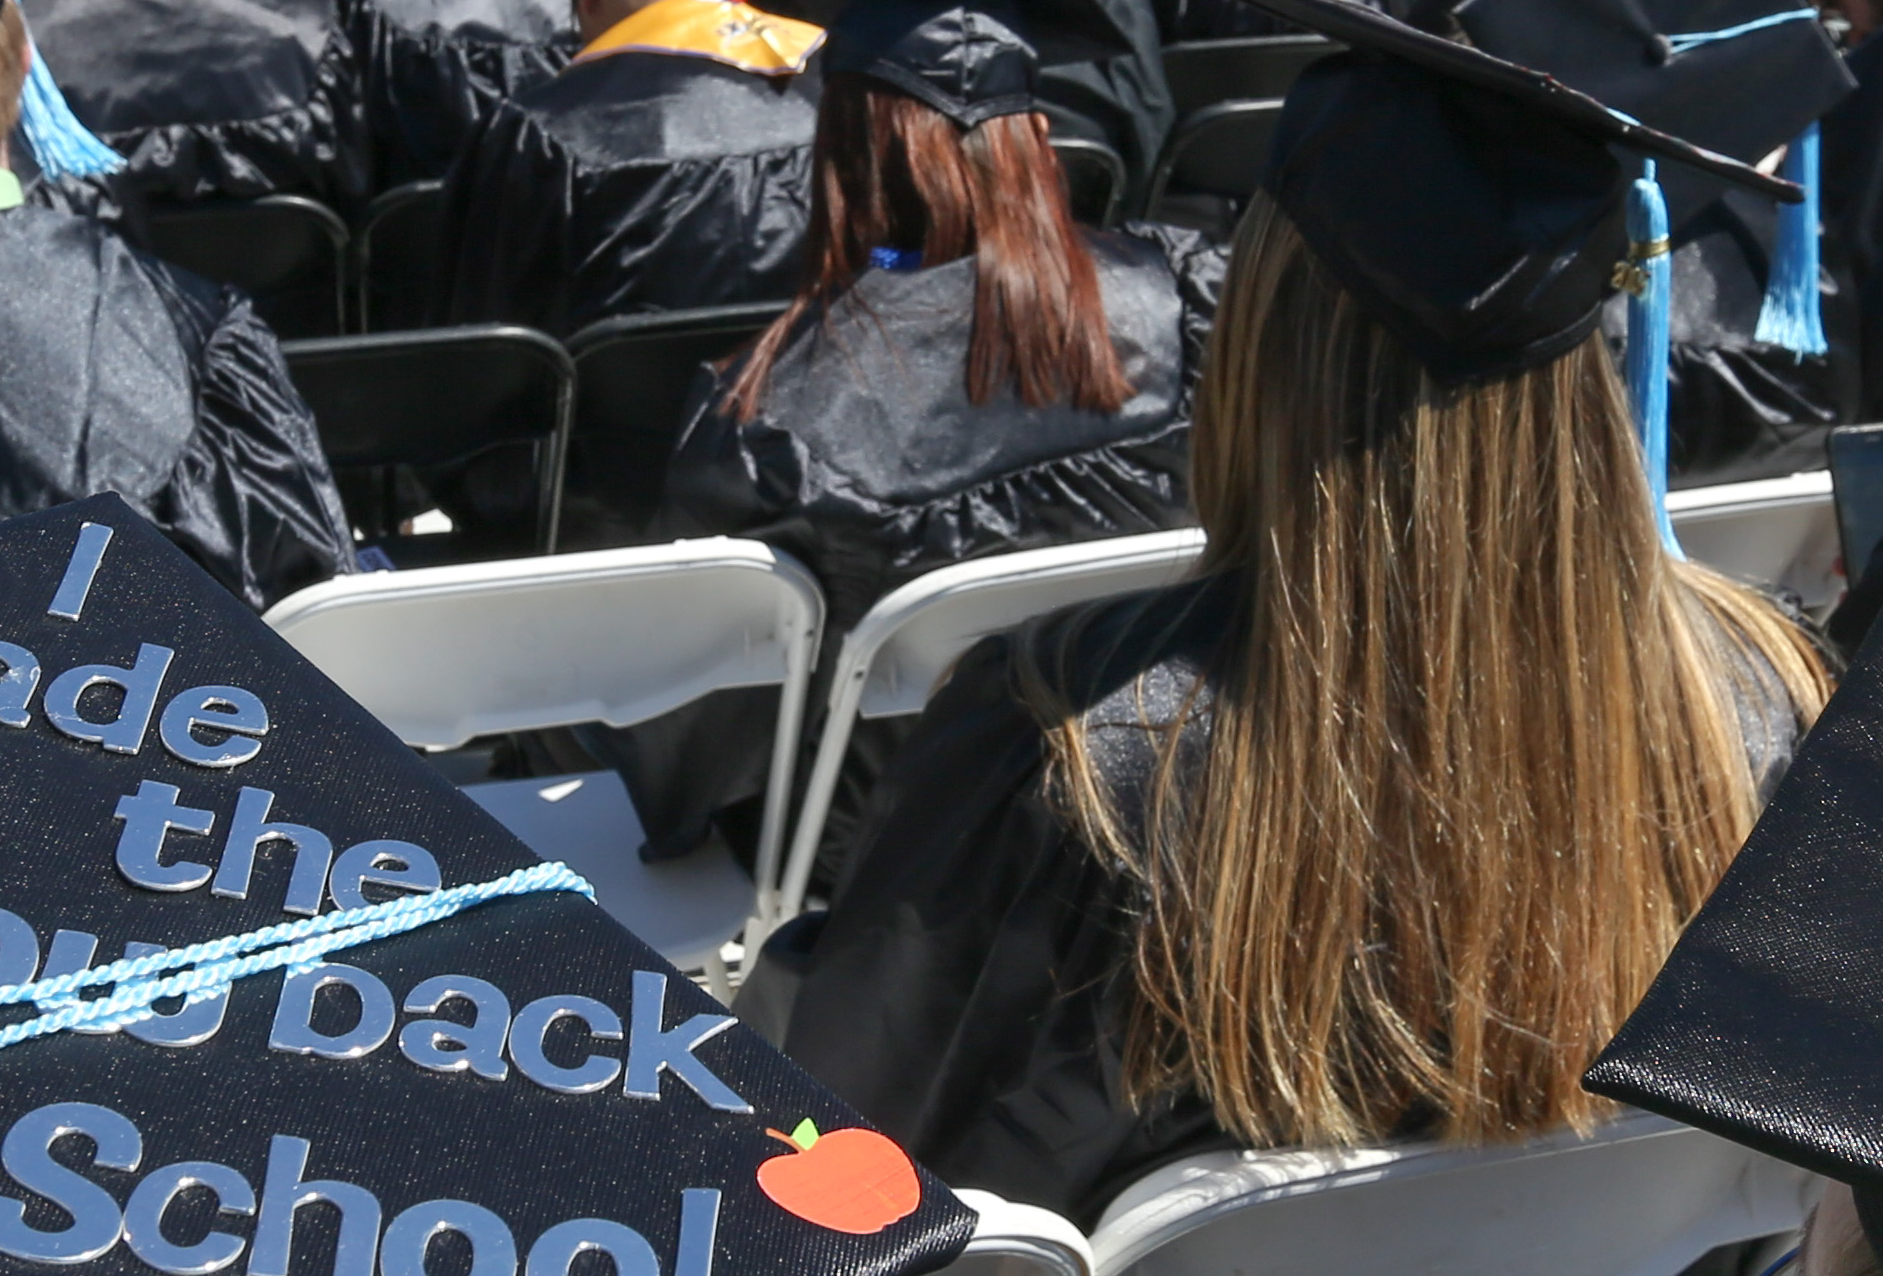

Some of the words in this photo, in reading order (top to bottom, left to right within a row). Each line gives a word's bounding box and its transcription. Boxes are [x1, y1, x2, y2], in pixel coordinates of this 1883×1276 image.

[47, 520, 114, 621] I
[115, 780, 443, 916] the
[268, 960, 755, 1113] back
